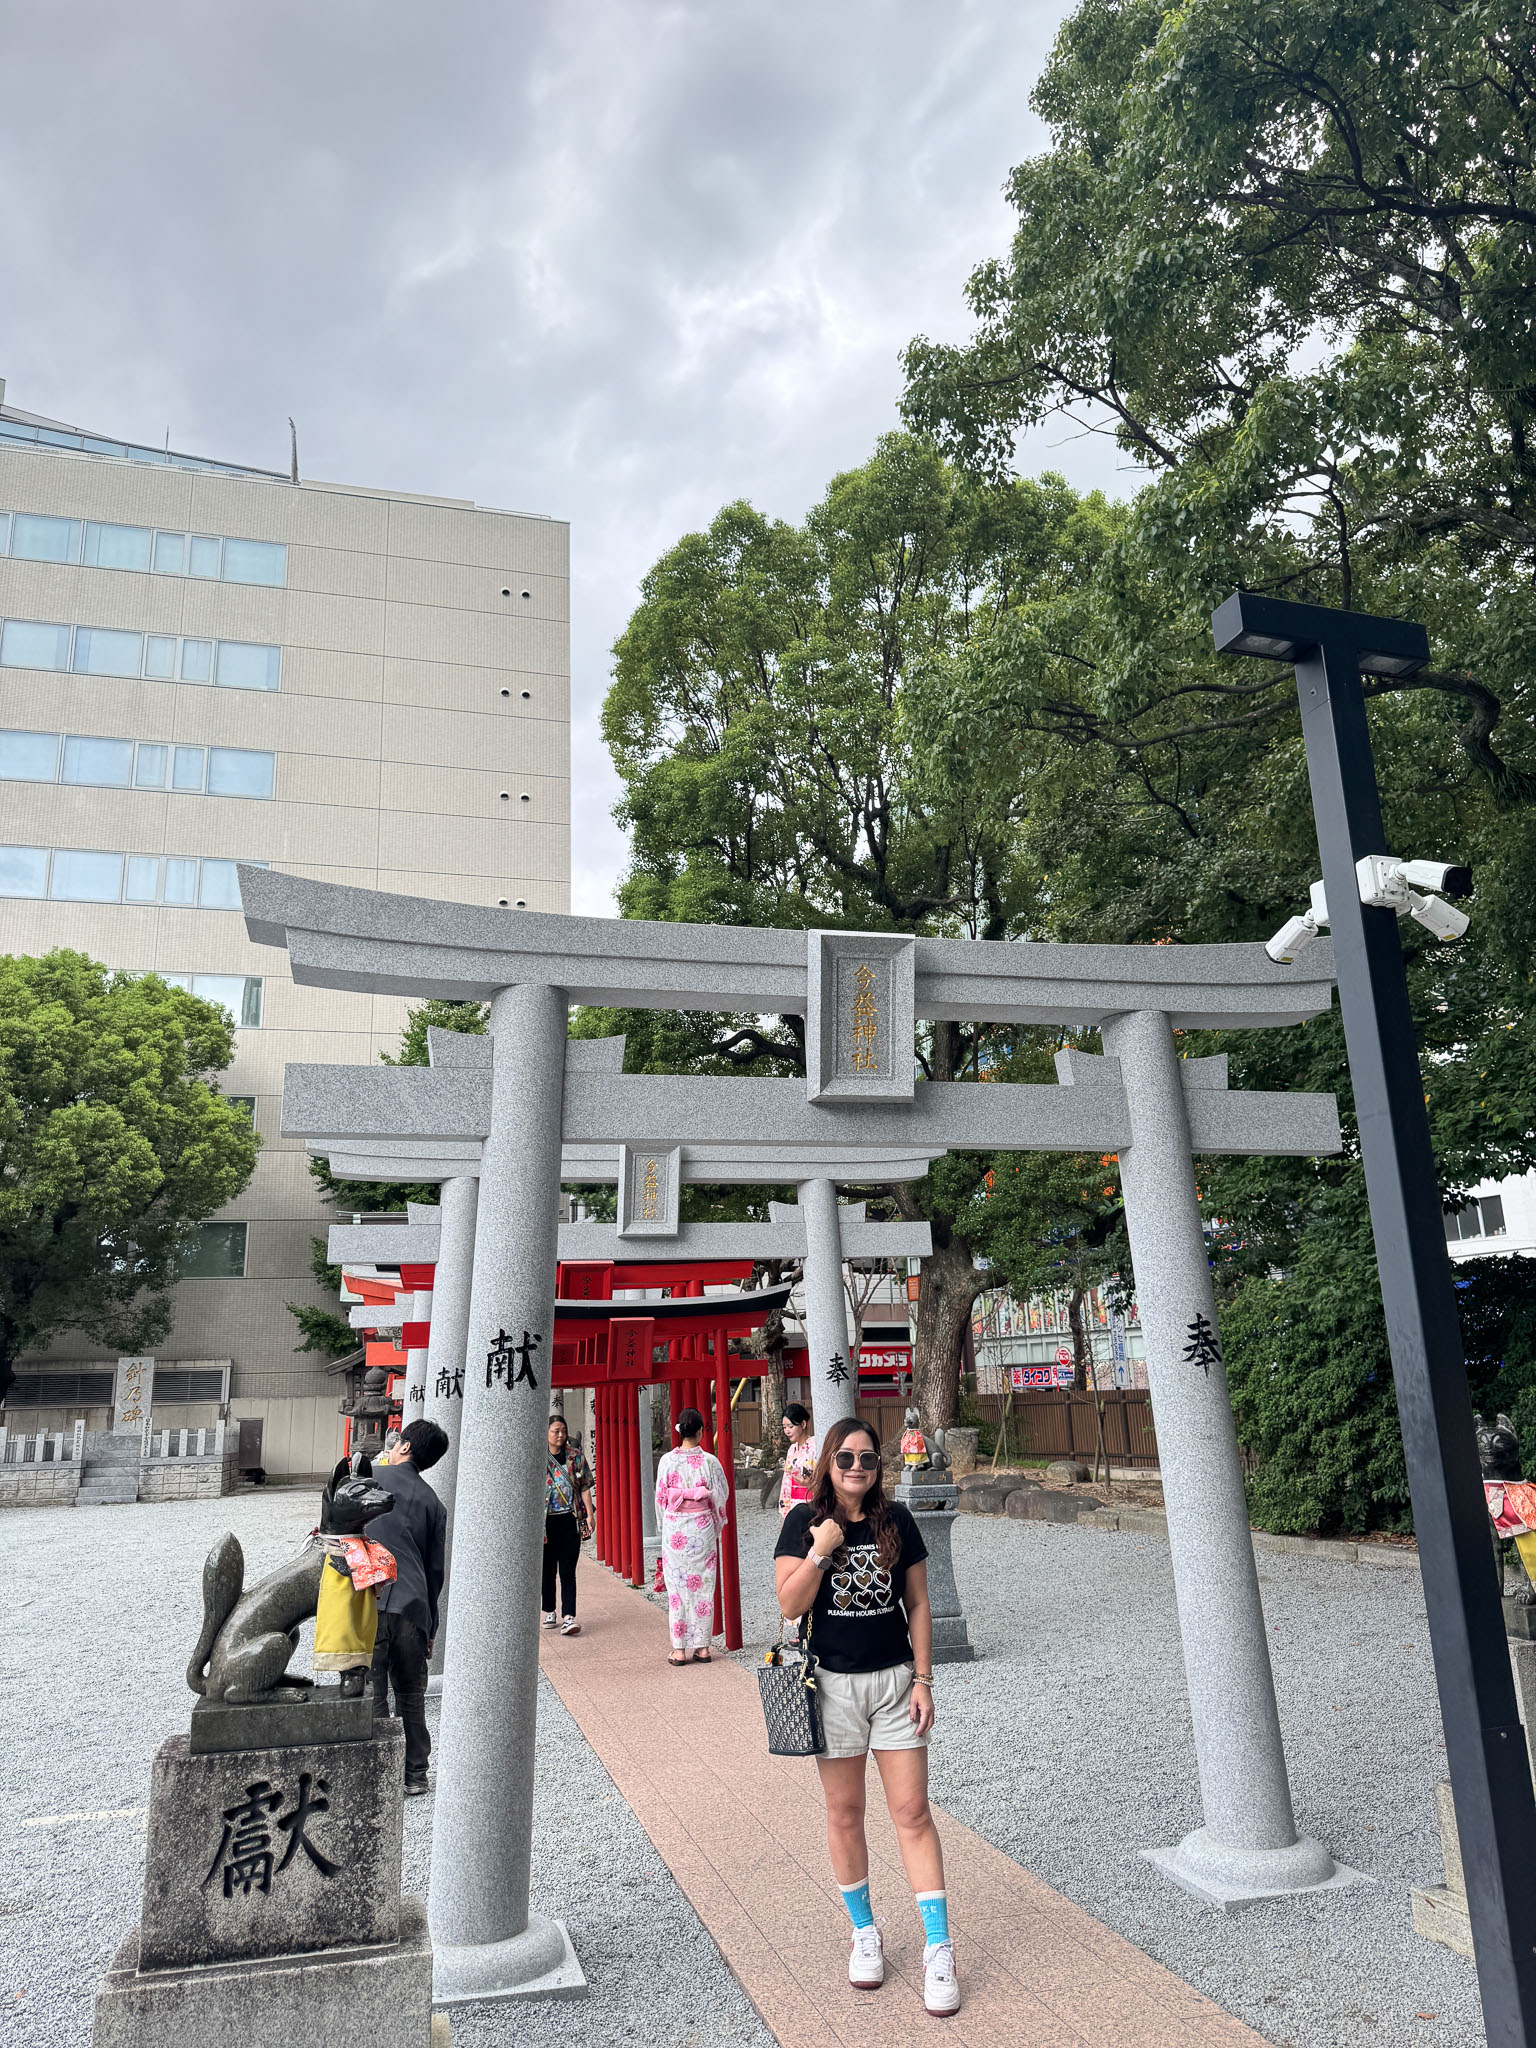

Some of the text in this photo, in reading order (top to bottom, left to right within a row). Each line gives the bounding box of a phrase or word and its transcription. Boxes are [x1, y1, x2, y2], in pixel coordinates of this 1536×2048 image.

[849, 964, 878, 1072] 今益神社
[643, 1159, 658, 1219] 今益神社
[485, 1328, 543, 1391] 献
[625, 1329, 638, 1368] 今益神社
[1182, 1312, 1223, 1378] 奉
[435, 1366, 465, 1399] 献
[826, 1352, 850, 1388] 奉
[1023, 1369, 1051, 1384] ダイコク
[827, 1609, 855, 1617] PLEASANT
[855, 1609, 877, 1617] HOURS
